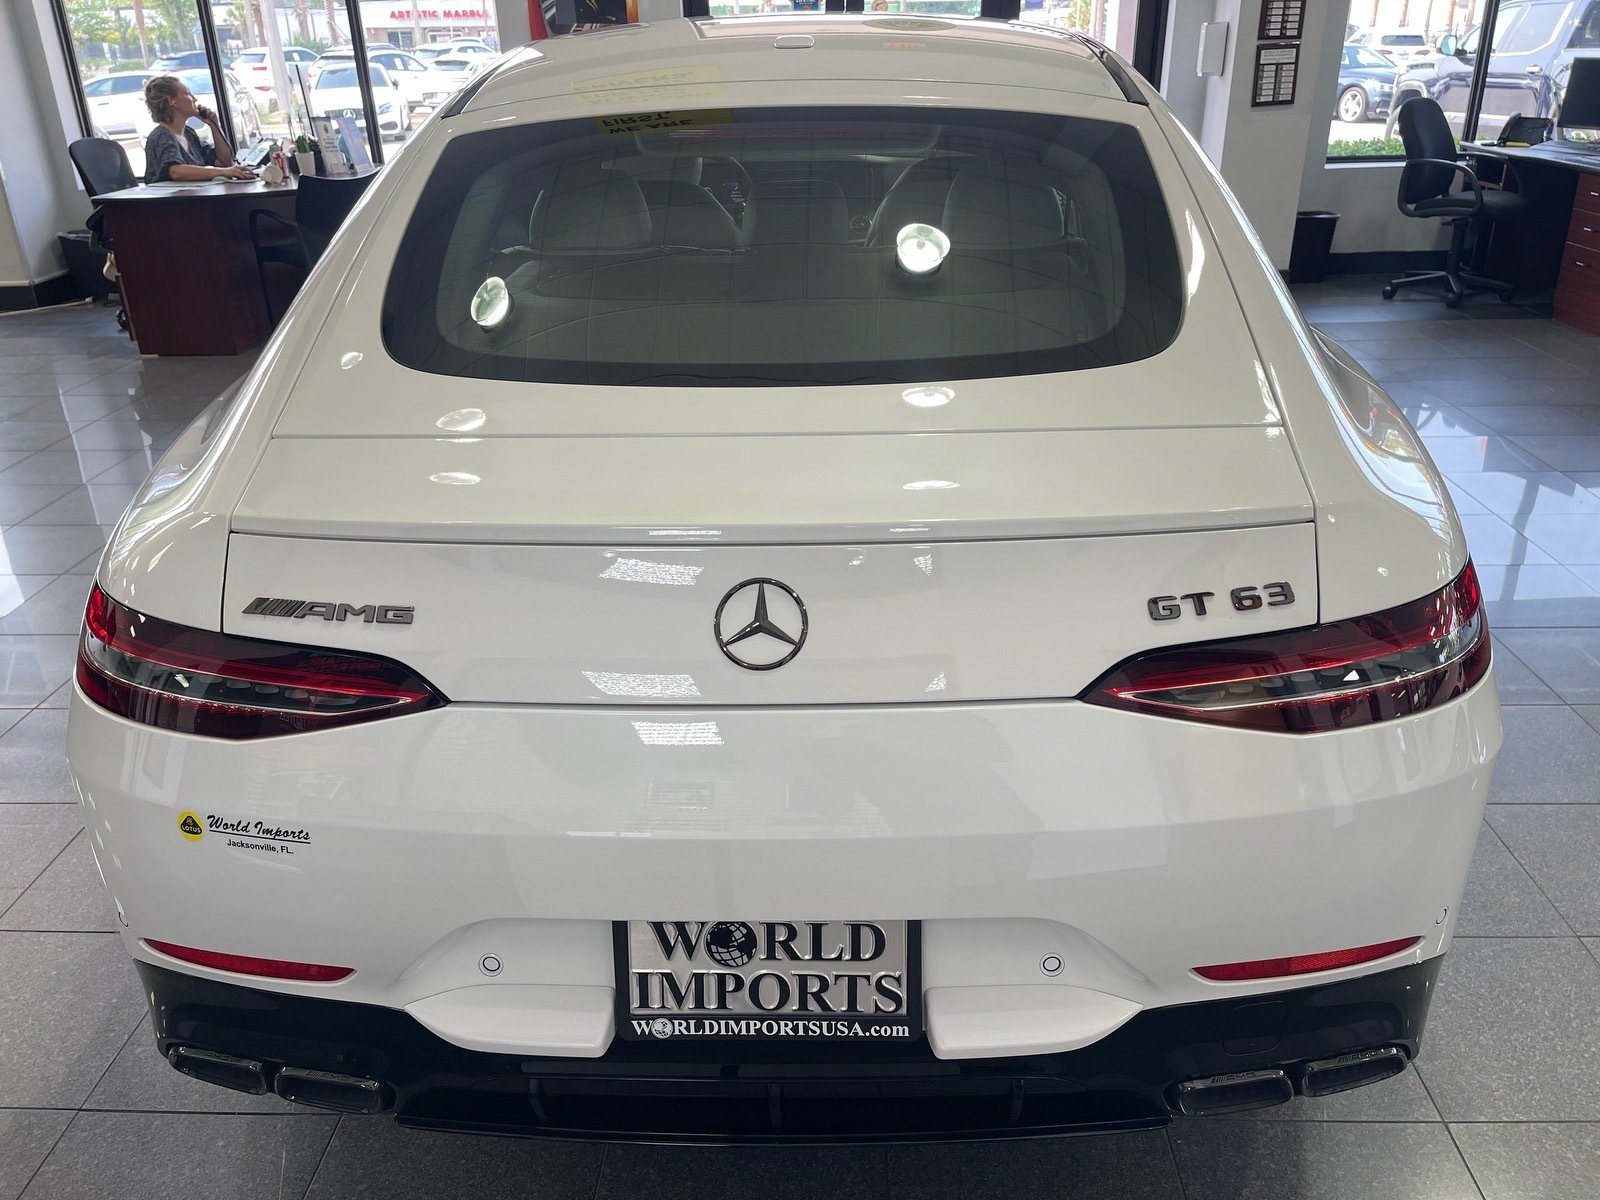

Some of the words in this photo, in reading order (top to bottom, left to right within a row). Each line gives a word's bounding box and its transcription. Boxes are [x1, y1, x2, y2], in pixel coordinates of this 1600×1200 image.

[390, 10, 438, 19] ARTSTIC
[1147, 591, 1215, 621] GT
[1231, 581, 1295, 612] 63
[181, 825, 202, 834] LOTUS
[207, 814, 251, 833] World
[254, 821, 311, 841] Imports
[226, 839, 279, 853] Jacksonville,
[280, 845, 294, 855] FL.
[631, 969, 904, 1013] IMPORTS
